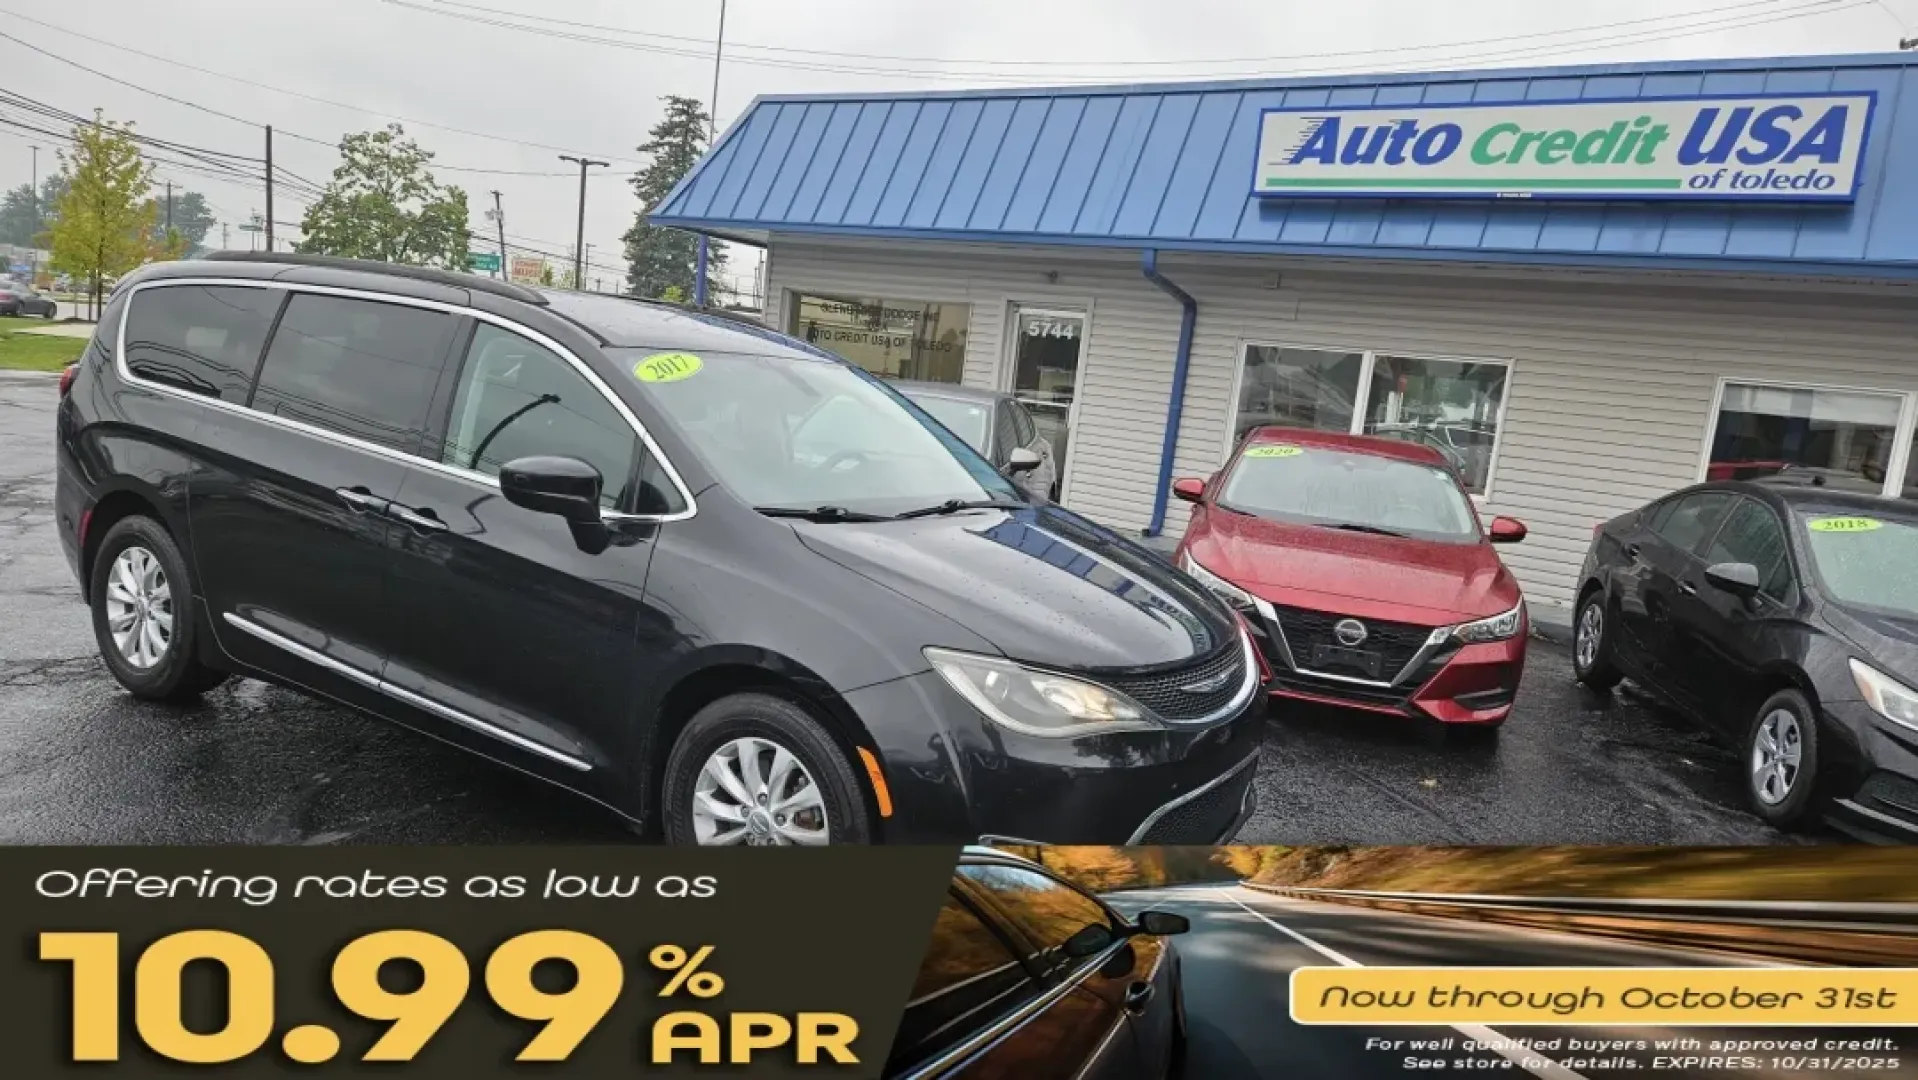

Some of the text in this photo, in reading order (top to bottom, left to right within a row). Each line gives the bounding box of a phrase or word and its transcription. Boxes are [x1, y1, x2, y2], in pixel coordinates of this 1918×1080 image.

[1286, 104, 1849, 165] Auto Credit USA
[1688, 168, 1835, 190] of toledo
[884, 308, 921, 321] DODGE
[835, 330, 869, 344] CREDIT
[871, 335, 891, 348] USA
[1029, 320, 1074, 340] 5744
[646, 354, 689, 379] 2017
[1823, 518, 1869, 531] 2018
